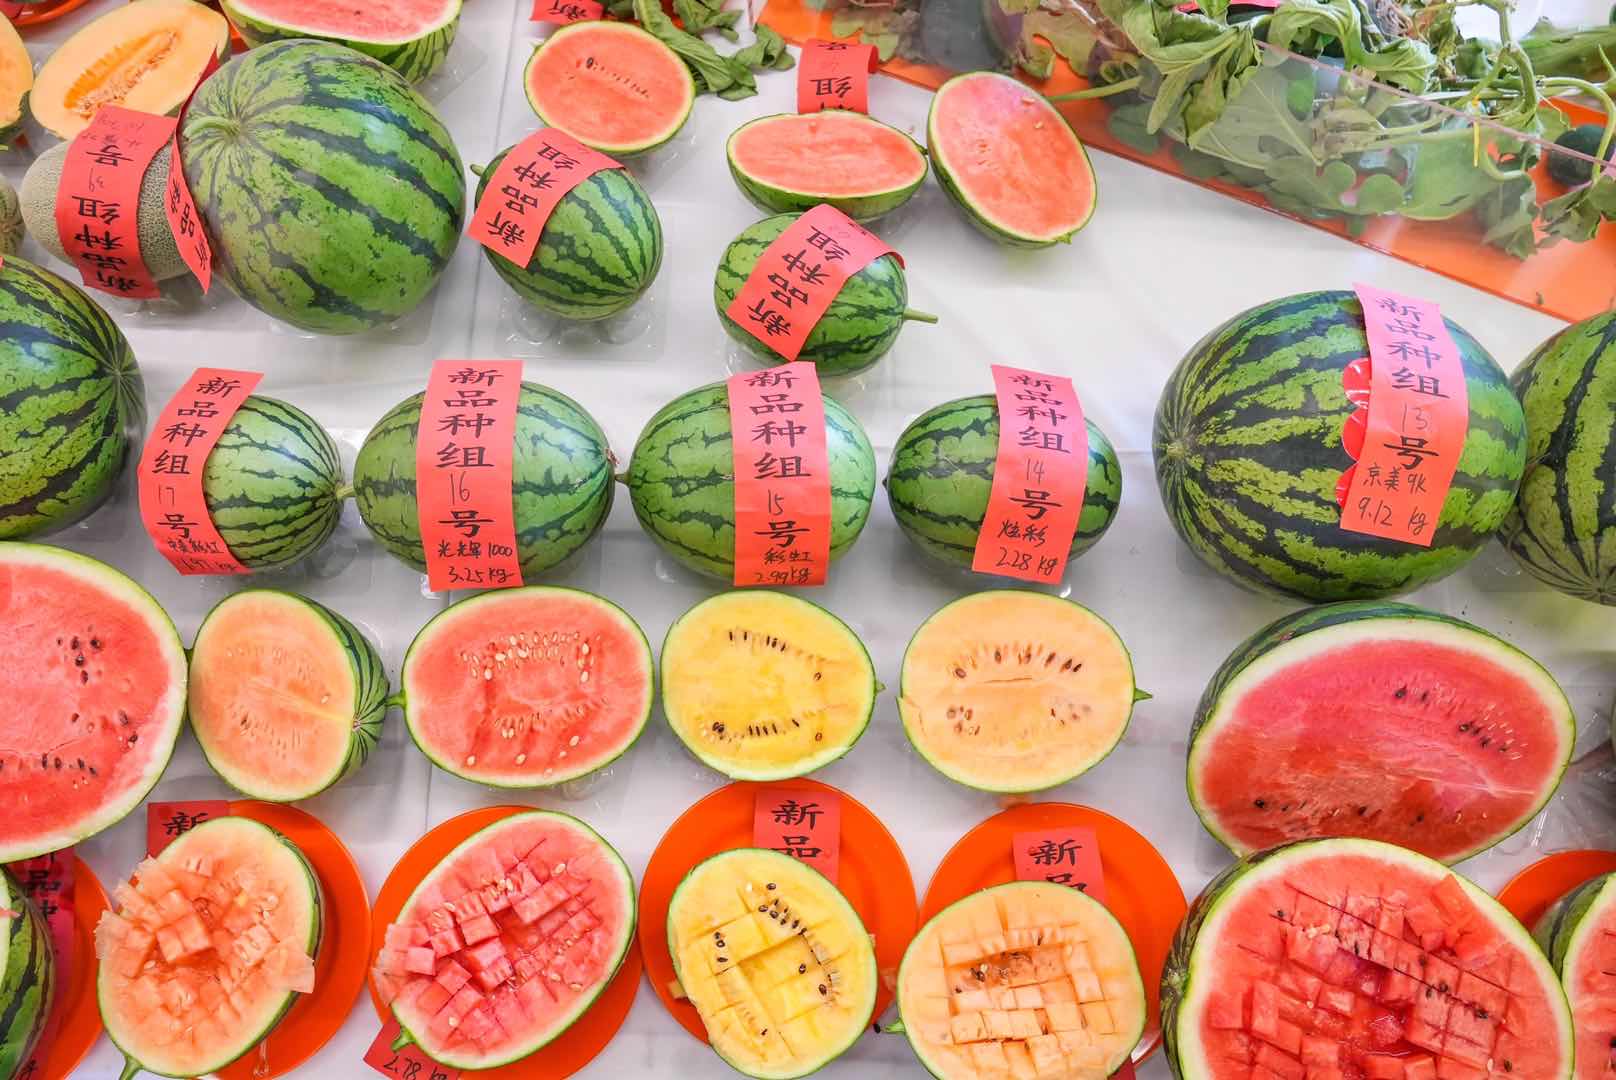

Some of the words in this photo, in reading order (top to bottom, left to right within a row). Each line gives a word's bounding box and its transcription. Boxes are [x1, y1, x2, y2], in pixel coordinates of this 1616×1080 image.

[486, 142, 582, 247] 新品种组
[747, 225, 850, 337] 新品种组
